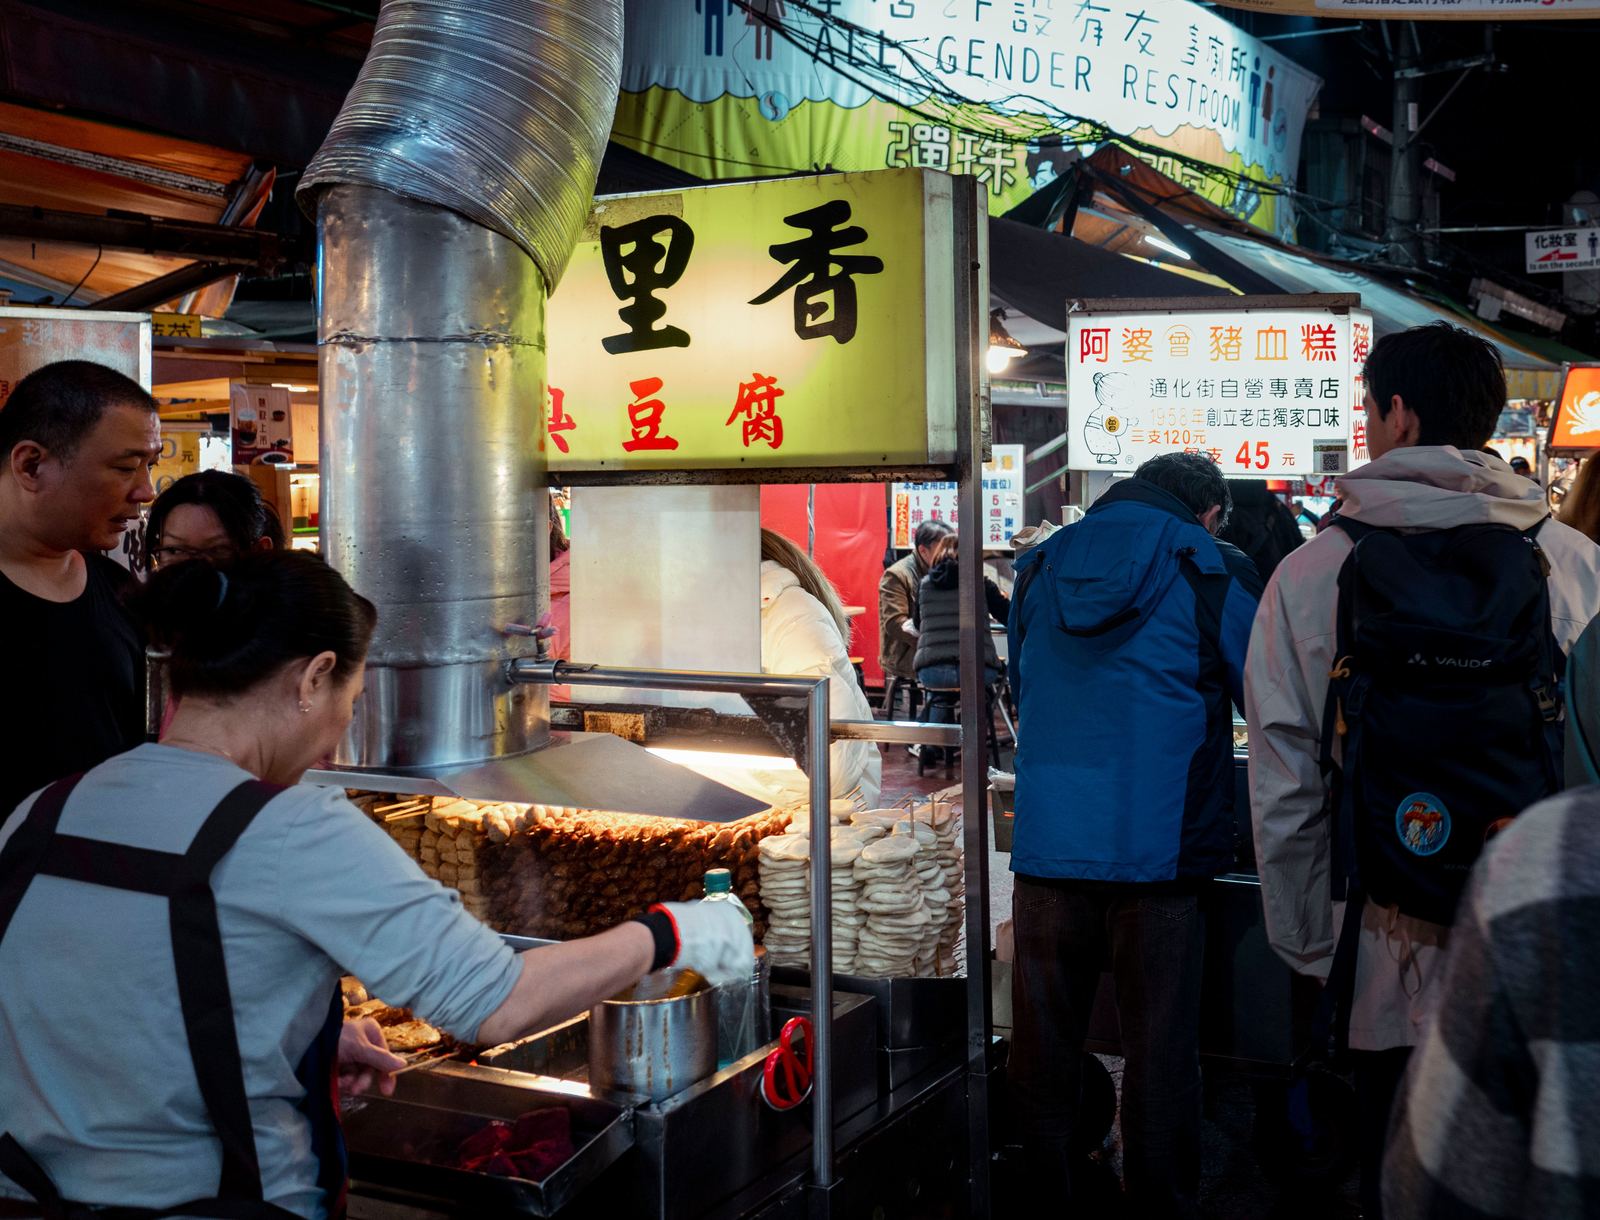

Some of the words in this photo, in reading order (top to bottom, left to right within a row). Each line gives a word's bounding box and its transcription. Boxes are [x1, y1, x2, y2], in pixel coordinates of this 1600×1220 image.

[812, 26, 897, 69] ALL
[936, 36, 1091, 92] GENDER
[1123, 64, 1241, 132] RESTROOM
[600, 199, 884, 355] 里香
[1150, 377, 1340, 399] 通化街自營專賣店
[1131, 429, 1207, 445] 三支120元
[1235, 440, 1271, 470] 45
[1281, 453, 1295, 466] 元
[1435, 656, 1492, 668] VAUDE
